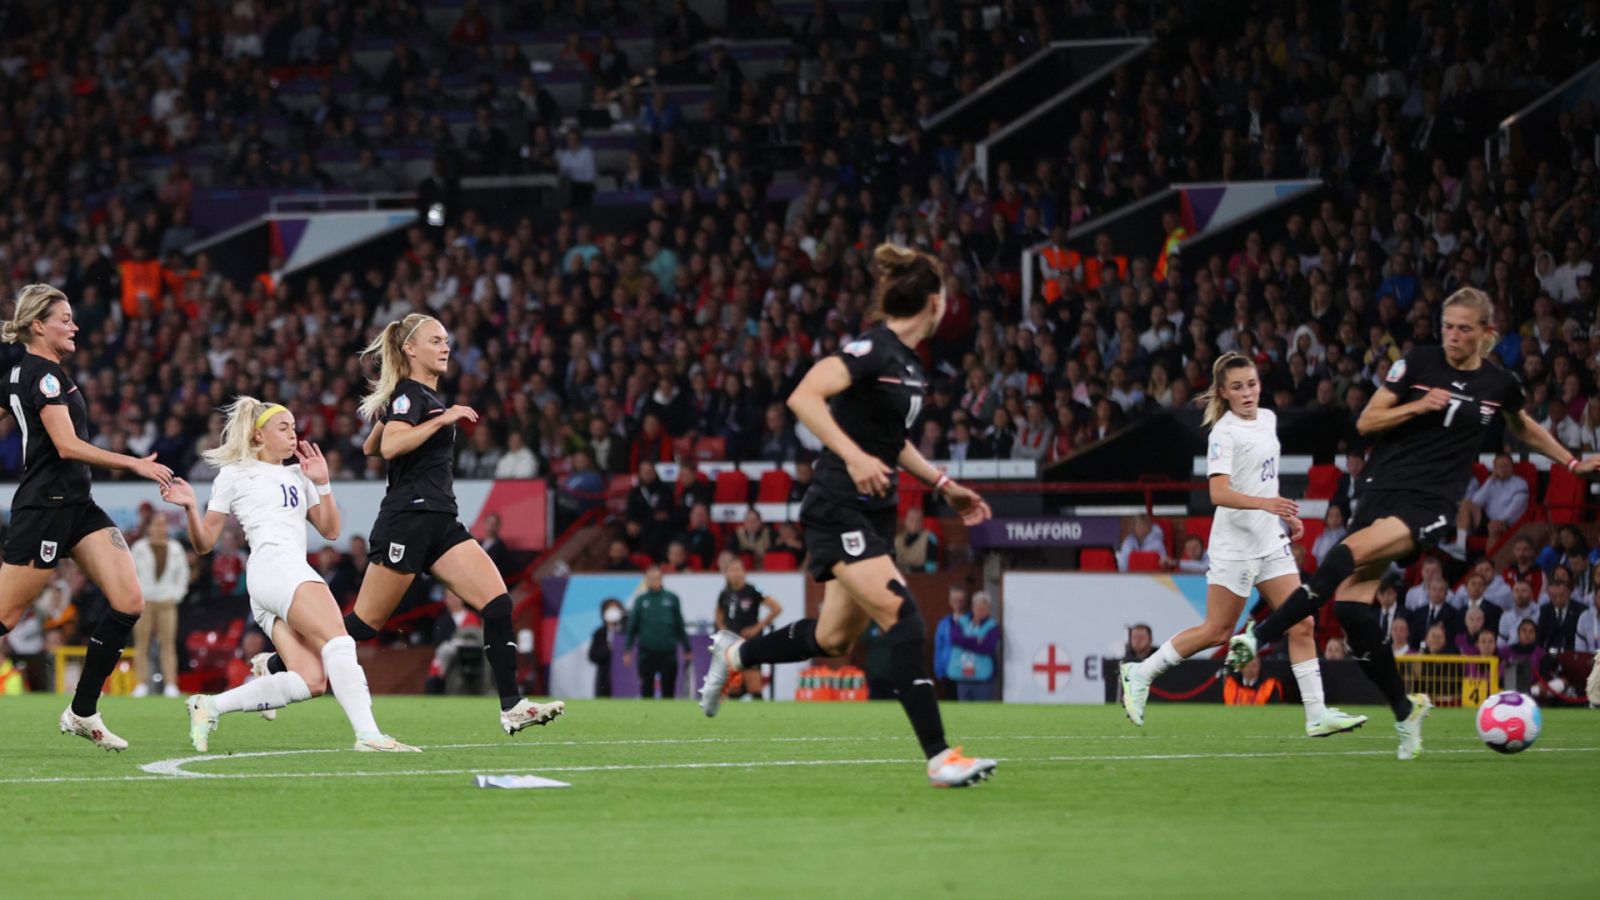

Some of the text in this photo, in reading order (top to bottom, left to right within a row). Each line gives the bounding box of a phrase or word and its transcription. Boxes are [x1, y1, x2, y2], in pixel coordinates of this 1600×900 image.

[1444, 400, 1462, 427] 7
[1261, 457, 1276, 482] 20
[280, 484, 299, 508] 18
[1006, 522, 1082, 540] TRAFFORD
[1469, 688, 1480, 705] 4
